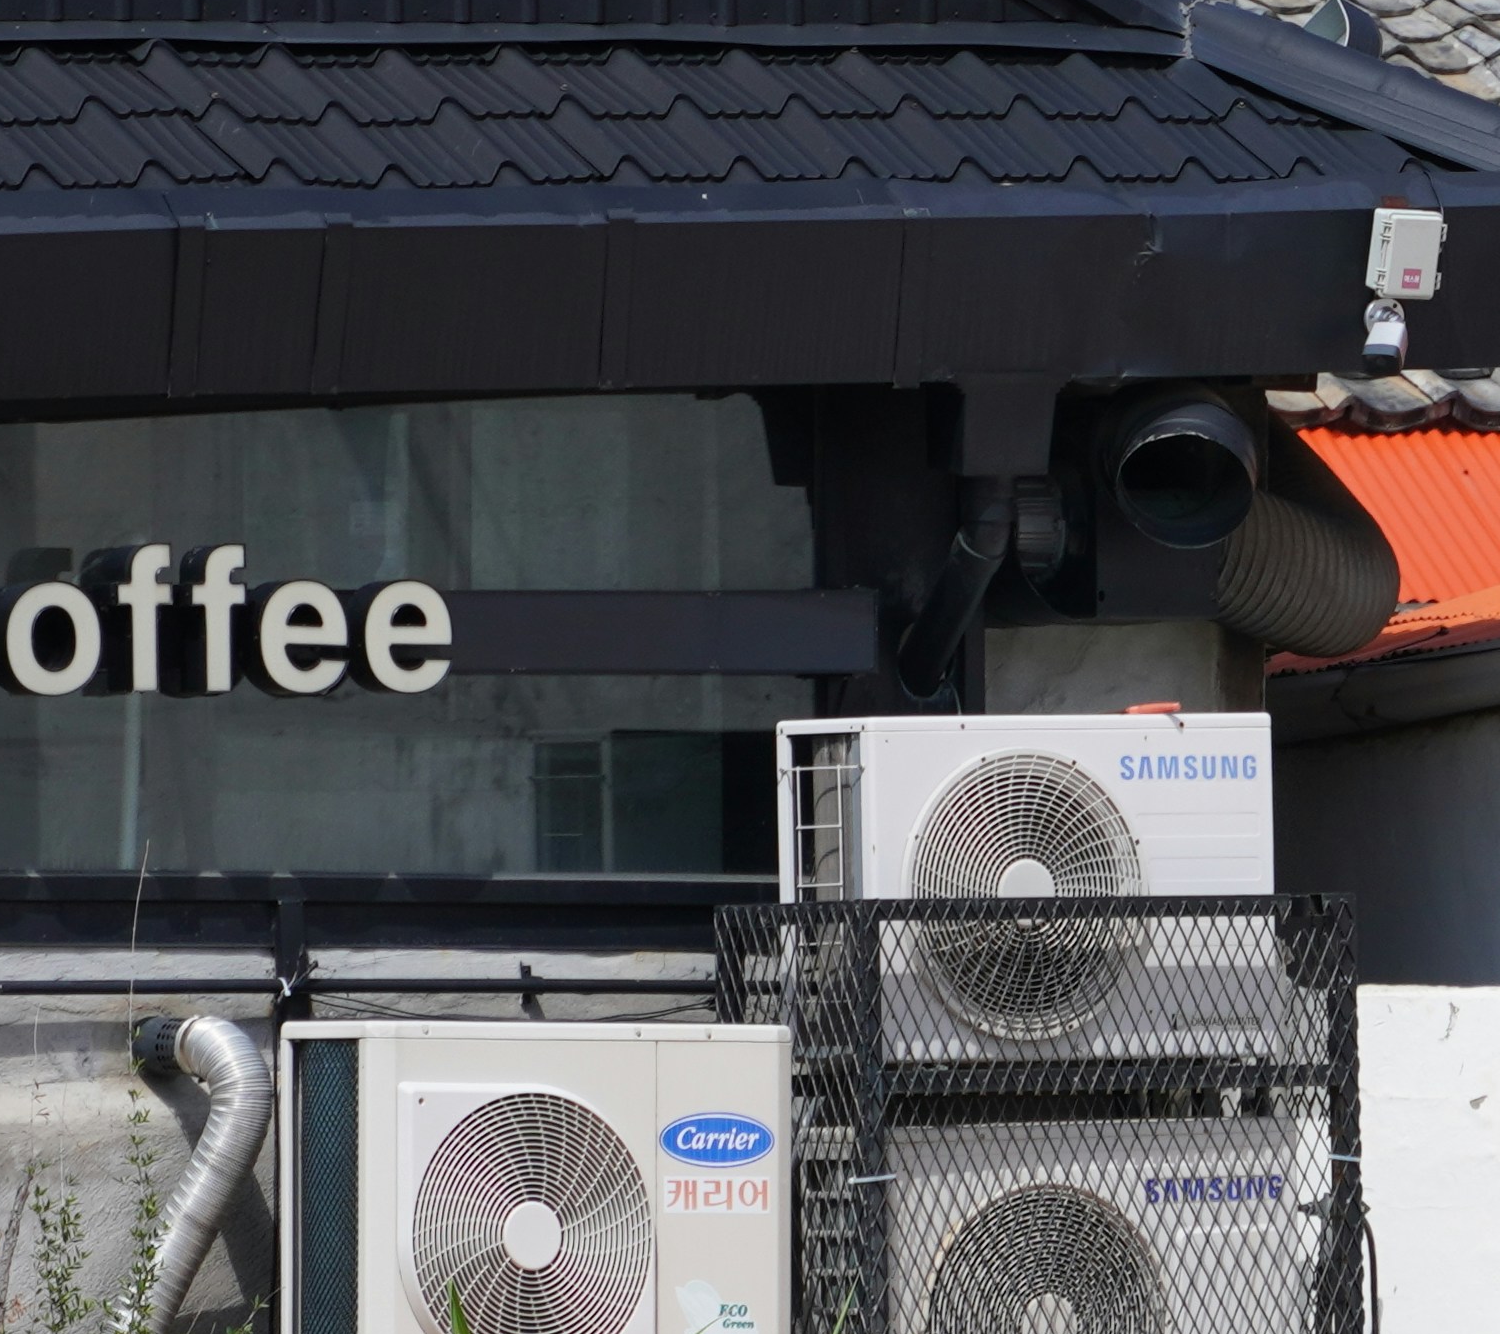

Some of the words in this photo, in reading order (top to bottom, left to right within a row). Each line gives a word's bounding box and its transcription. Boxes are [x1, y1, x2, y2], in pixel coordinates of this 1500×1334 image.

[1120, 755, 1257, 780] SAMSUNG
[676, 1126, 760, 1151] Carrier
[666, 1180, 769, 1211] 캐리어
[1145, 1174, 1283, 1204] SAMSUNG
[718, 1304, 748, 1318] ECO
[722, 1318, 755, 1329] Green
